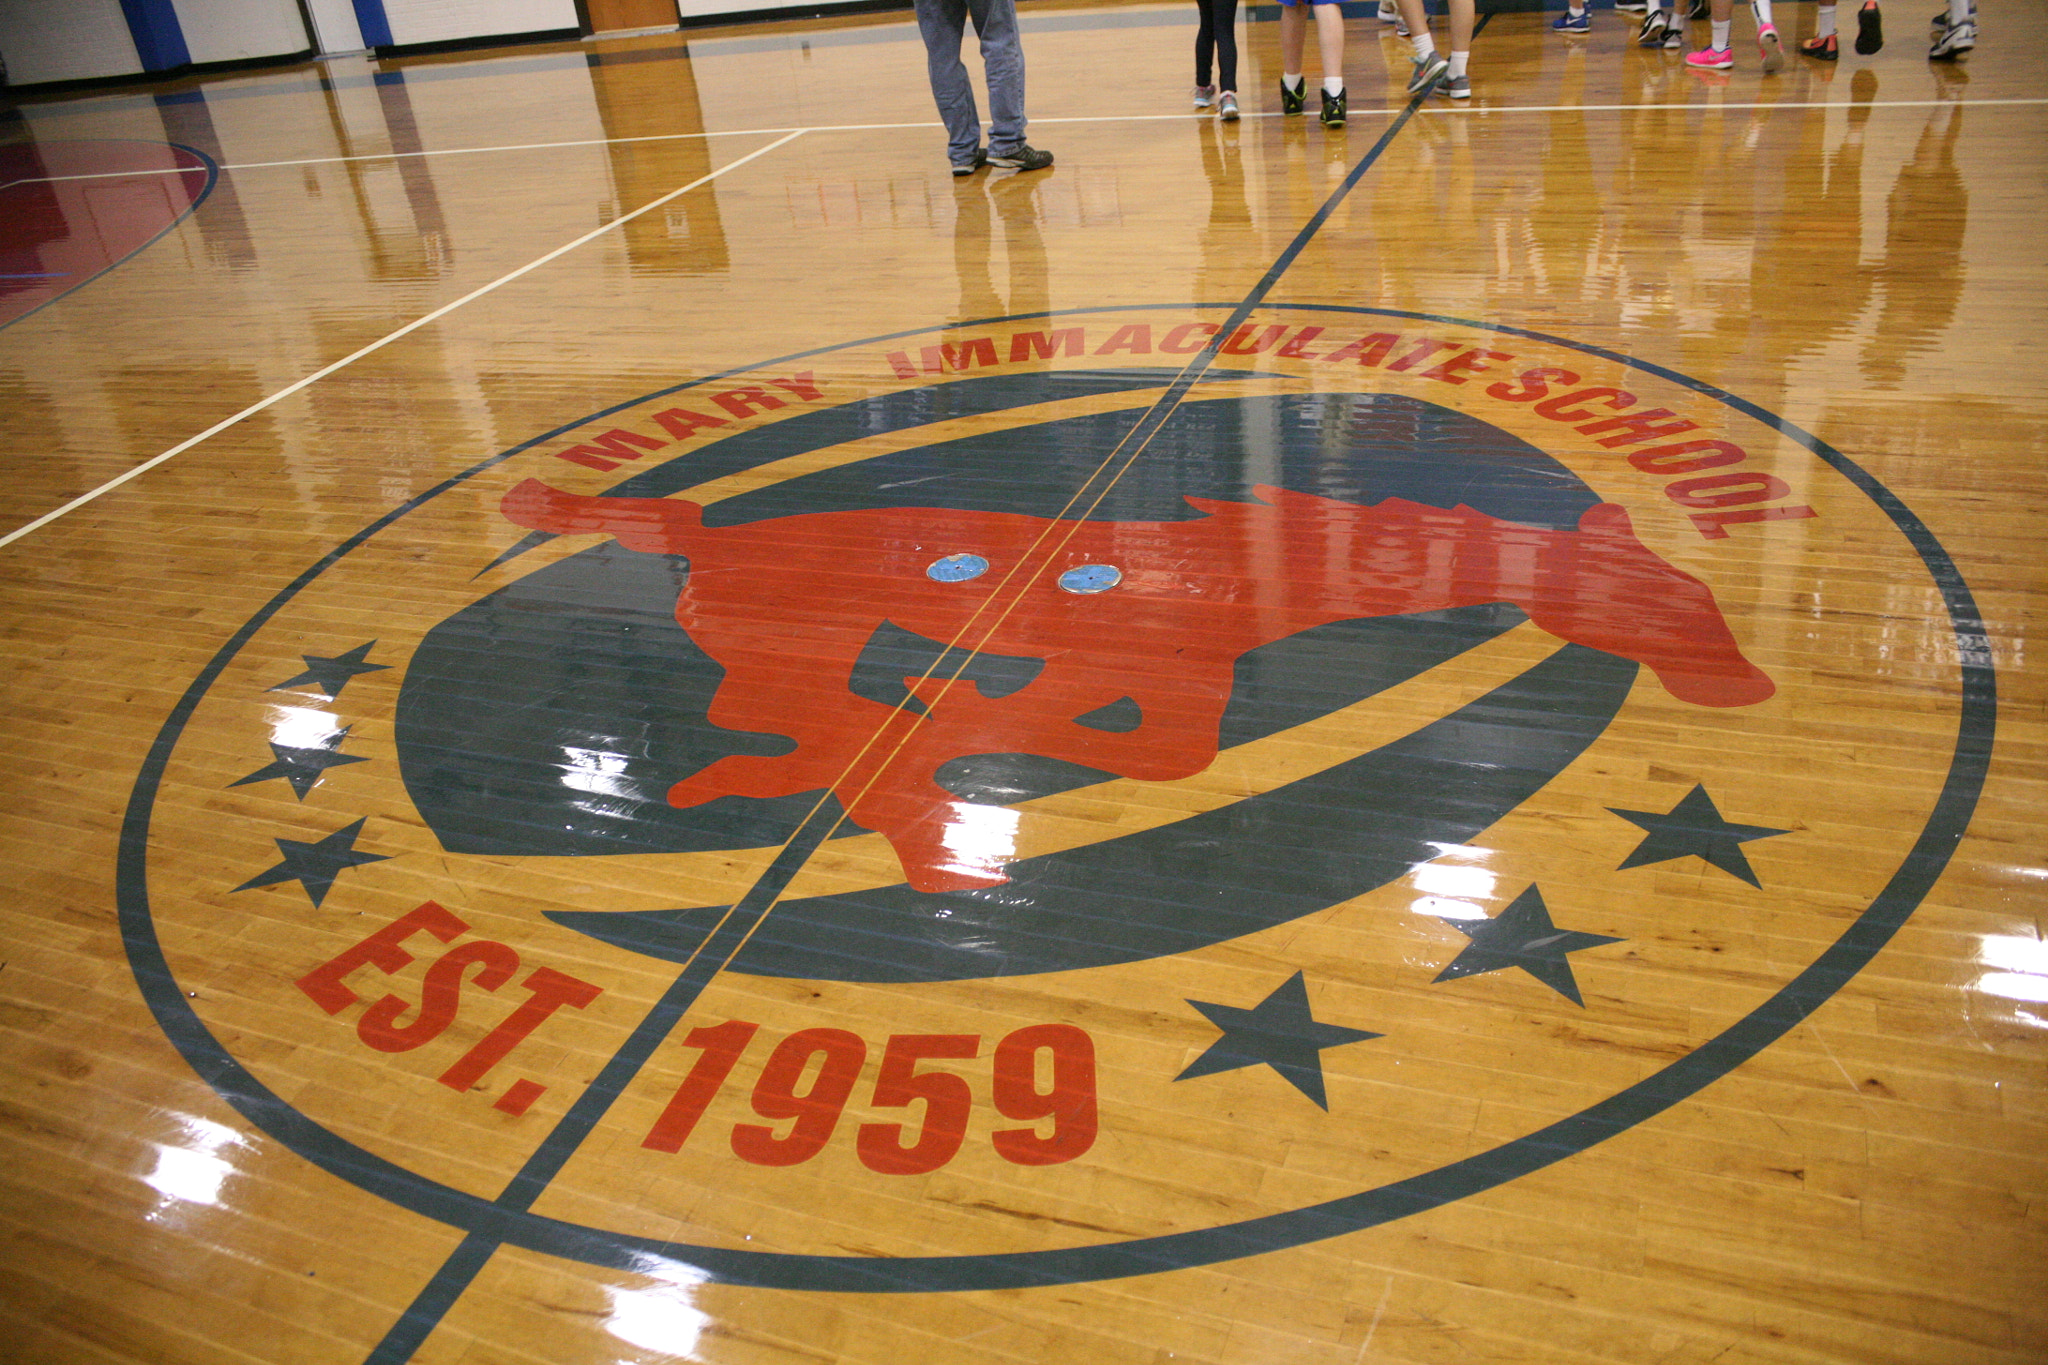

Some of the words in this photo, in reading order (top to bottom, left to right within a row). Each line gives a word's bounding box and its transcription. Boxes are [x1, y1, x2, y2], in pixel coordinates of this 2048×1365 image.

[555, 370, 825, 473] MARY
[886, 322, 1516, 385] IMMACULATE
[1485, 366, 1819, 540] SCHOOL
[293, 899, 604, 1118] EST.
[640, 1019, 1099, 1175] 1959
